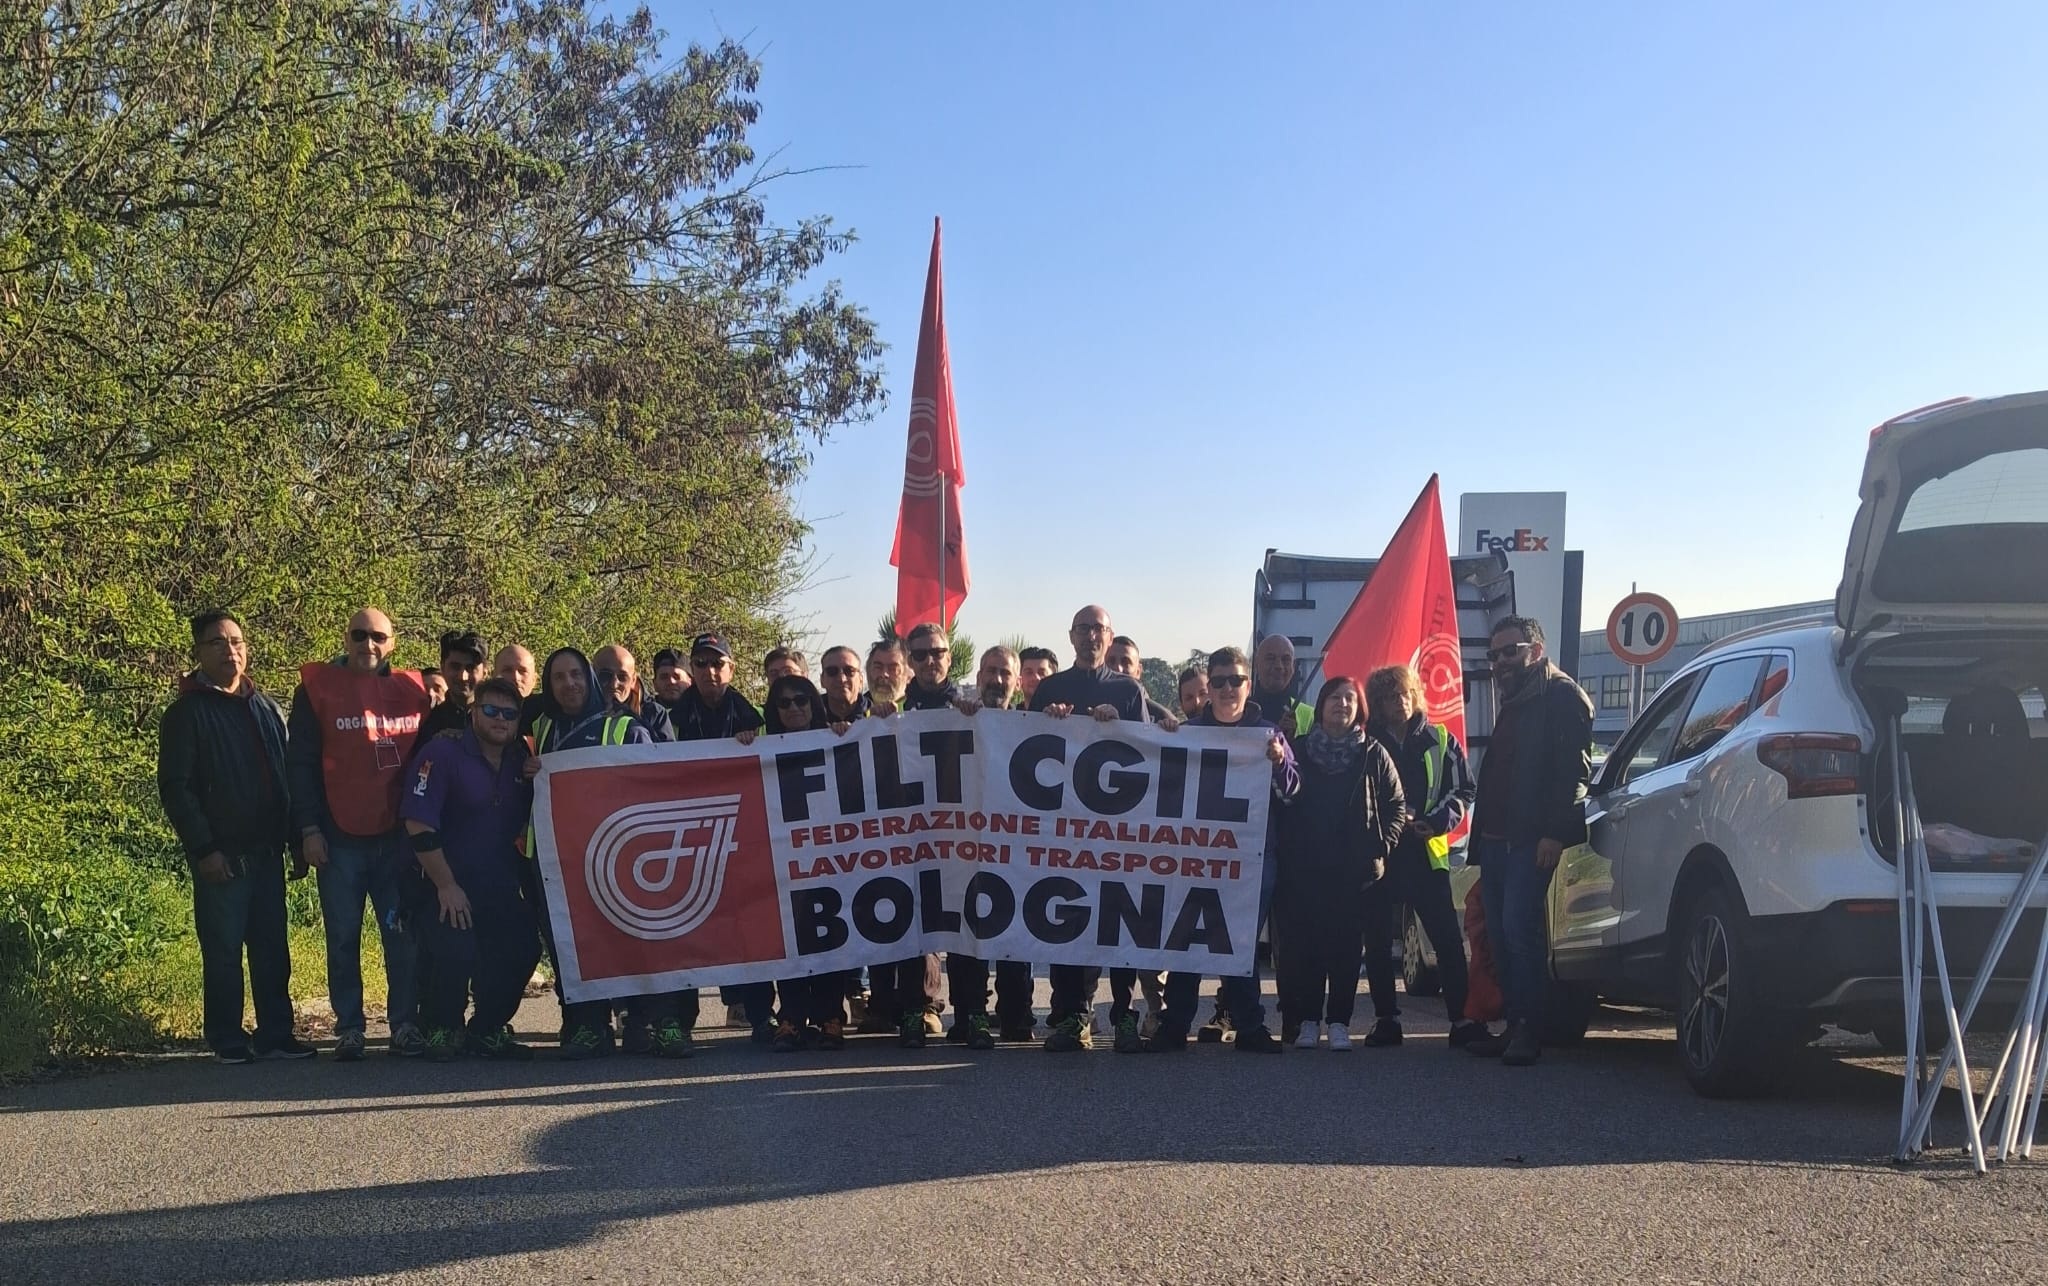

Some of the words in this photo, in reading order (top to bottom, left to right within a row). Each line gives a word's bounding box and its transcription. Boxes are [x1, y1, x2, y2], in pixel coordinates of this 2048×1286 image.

[1476, 529, 1549, 552] FedEx
[1621, 611, 1665, 647] 10
[775, 730, 974, 822] FILT
[1009, 733, 1250, 823] CGIL
[790, 810, 1041, 848] FEDERAZIONE
[1055, 817, 1238, 849] ITALIANA
[788, 840, 1011, 880] LAVORATORI
[1026, 846, 1241, 880] TRASPORTI
[790, 868, 1234, 956] BOLOGNA
